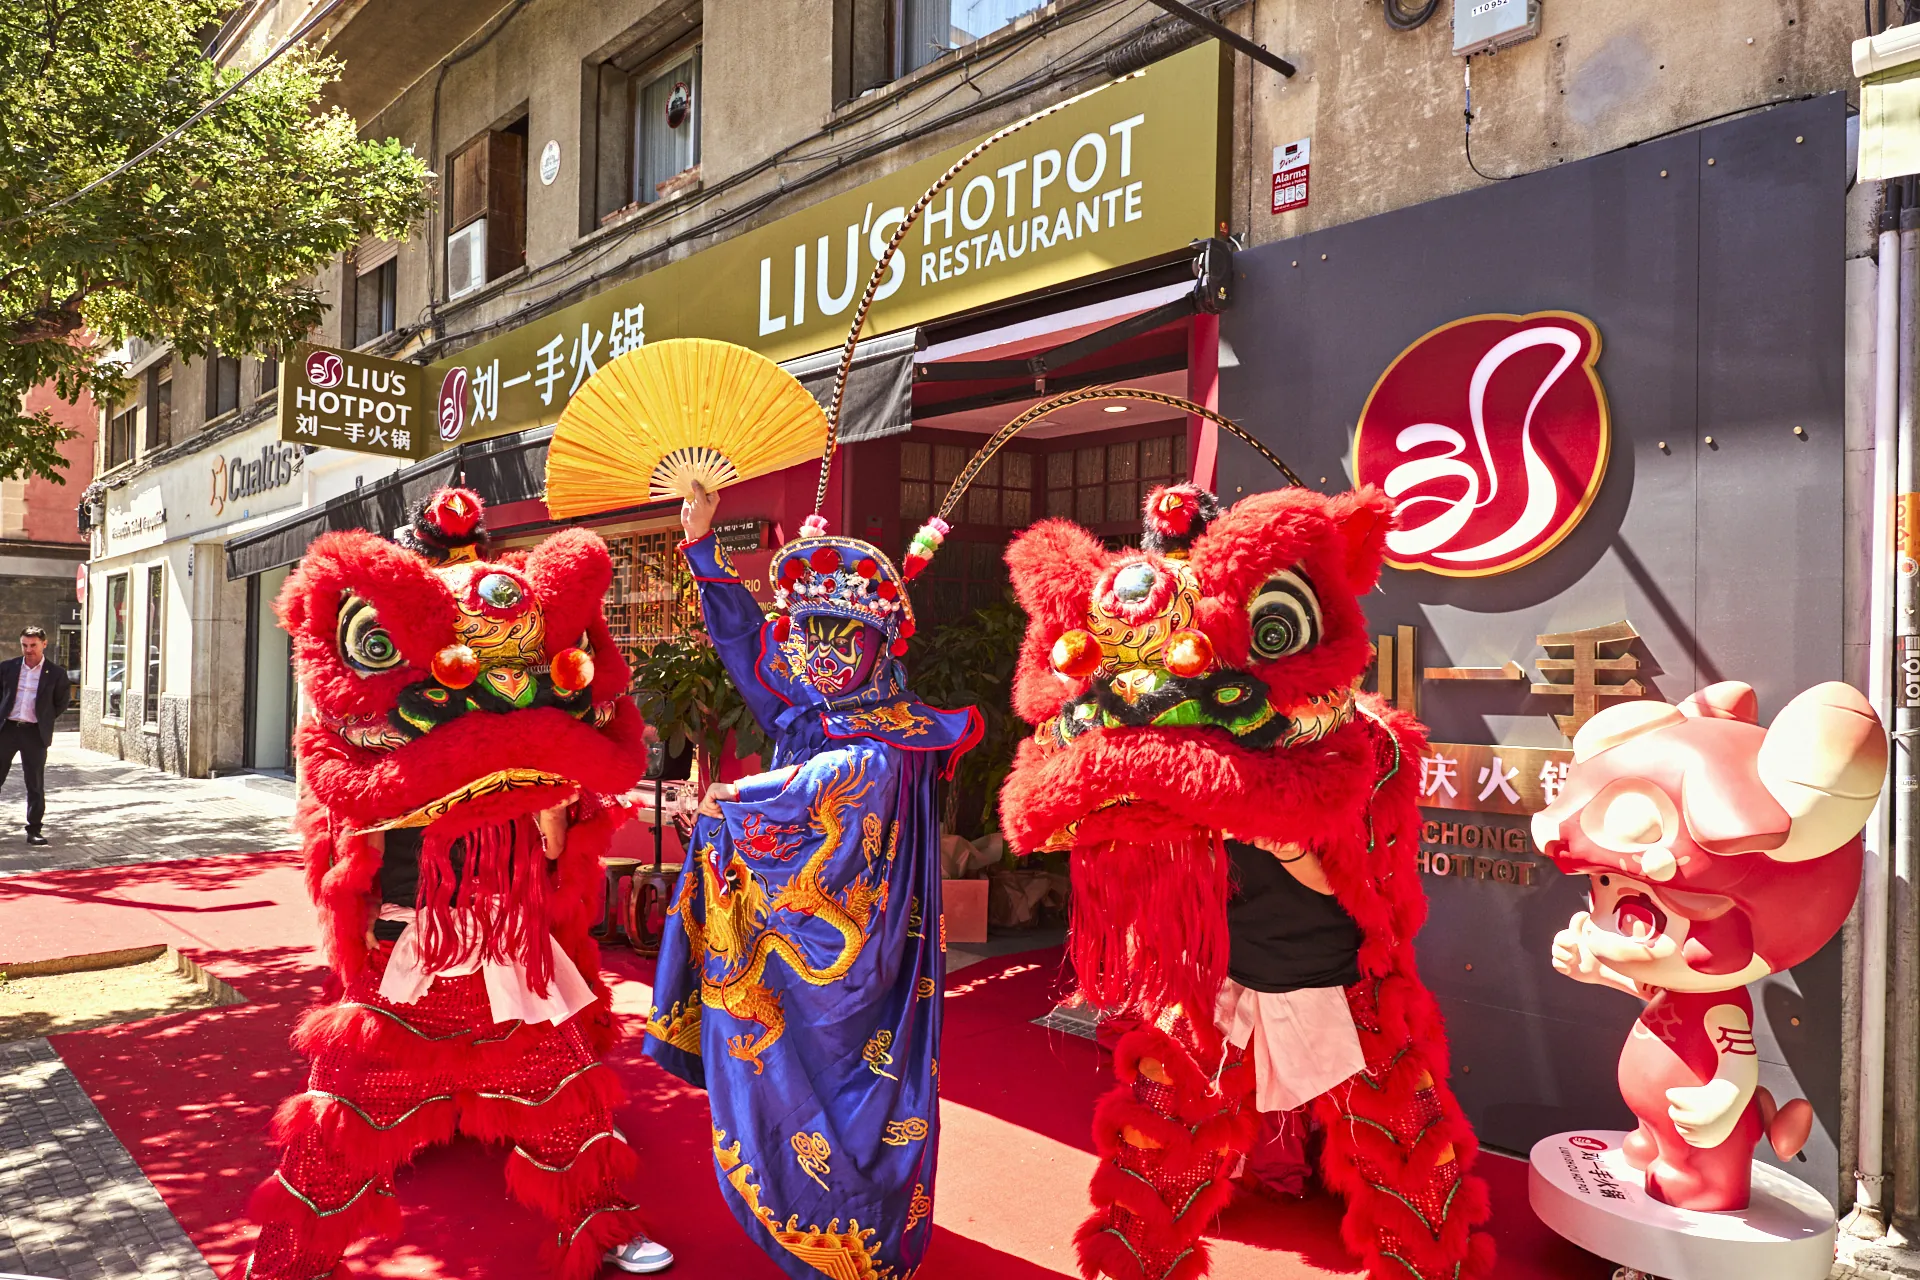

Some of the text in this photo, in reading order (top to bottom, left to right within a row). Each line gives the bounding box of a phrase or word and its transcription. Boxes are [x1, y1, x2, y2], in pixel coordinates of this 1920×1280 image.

[923, 113, 1144, 246] HOTPOT
[1275, 169, 1307, 184] Alarma
[921, 181, 1143, 286] RESTAURANTE
[758, 202, 907, 337] LIU'S
[347, 365, 406, 396] LIU'S
[470, 302, 645, 427] 刘一手火锅
[296, 386, 412, 426] HOTPOT
[295, 413, 411, 451] 刘一手火锅
[229, 440, 292, 501] Cualtis
[741, 578, 761, 593] RIO
[1421, 820, 1528, 854] CHONG
